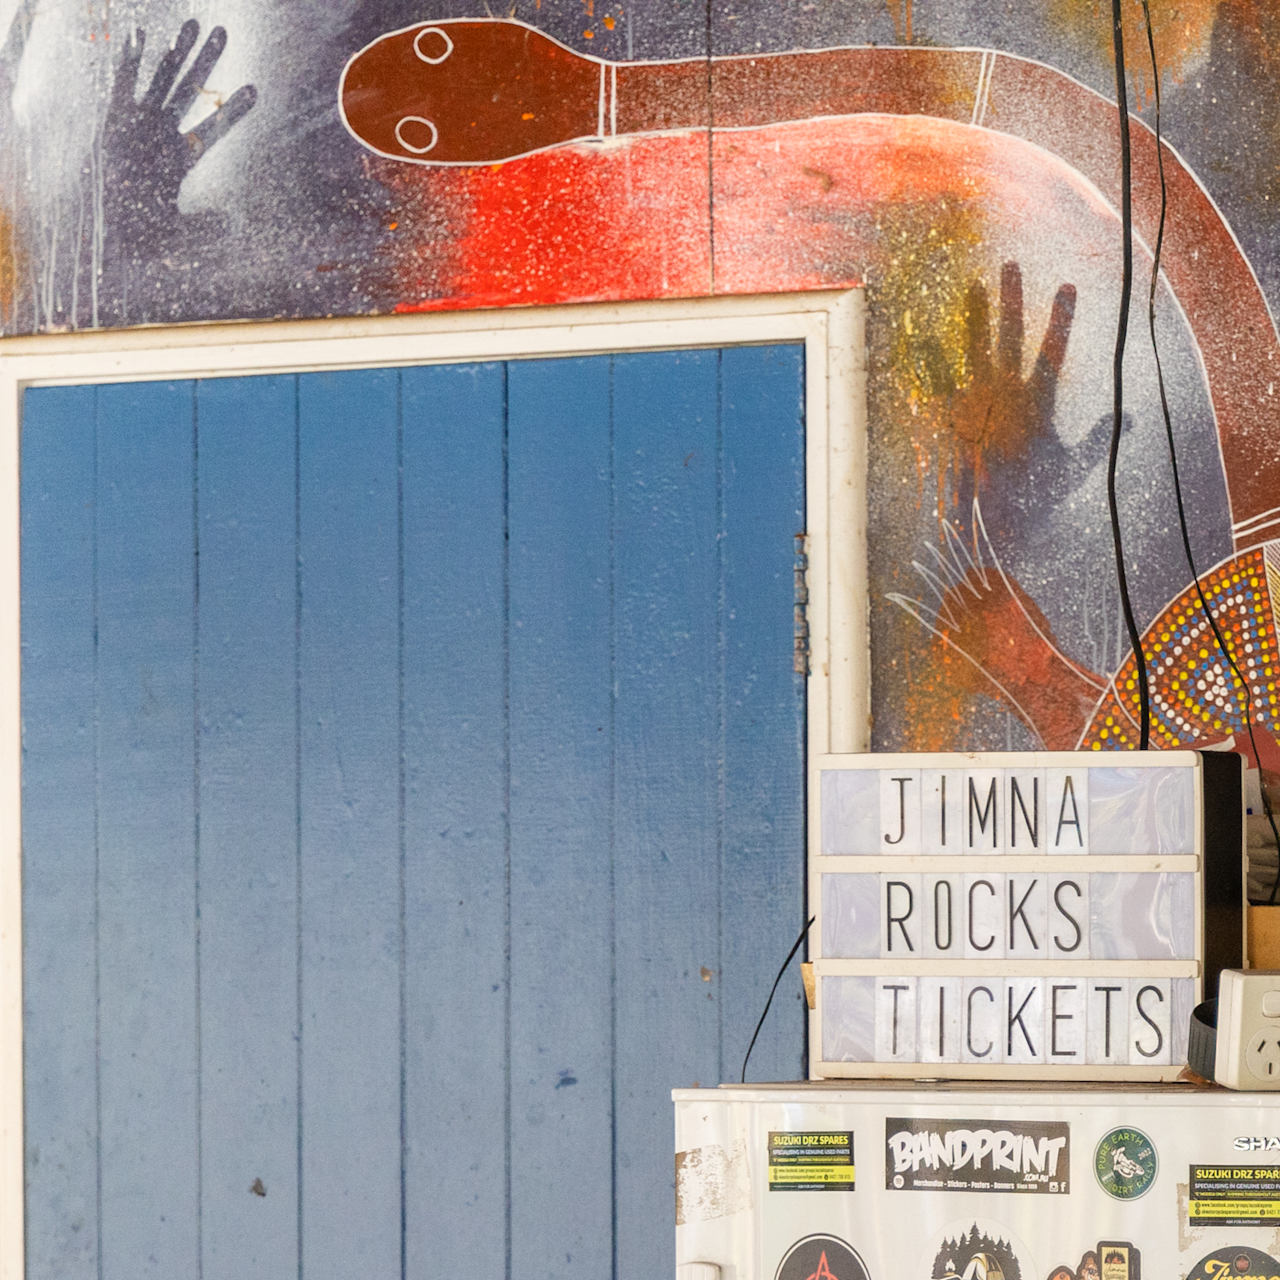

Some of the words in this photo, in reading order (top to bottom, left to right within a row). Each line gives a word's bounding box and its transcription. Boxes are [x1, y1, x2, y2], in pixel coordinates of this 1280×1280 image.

[884, 775, 1083, 848] JIMNA
[885, 879, 1082, 952] ROCKS
[882, 985, 1164, 1058] TICKETS
[773, 1135, 802, 1145] SUZUKI
[802, 1135, 819, 1145] DRZ
[819, 1135, 849, 1145] SPARES
[888, 1129, 1067, 1177] BANDPRINT
[1098, 1142, 1110, 1170] PURE
[1111, 1132, 1144, 1146] EARTH
[1196, 1169, 1231, 1179] SUZUKI
[1233, 1169, 1253, 1179] DRZ
